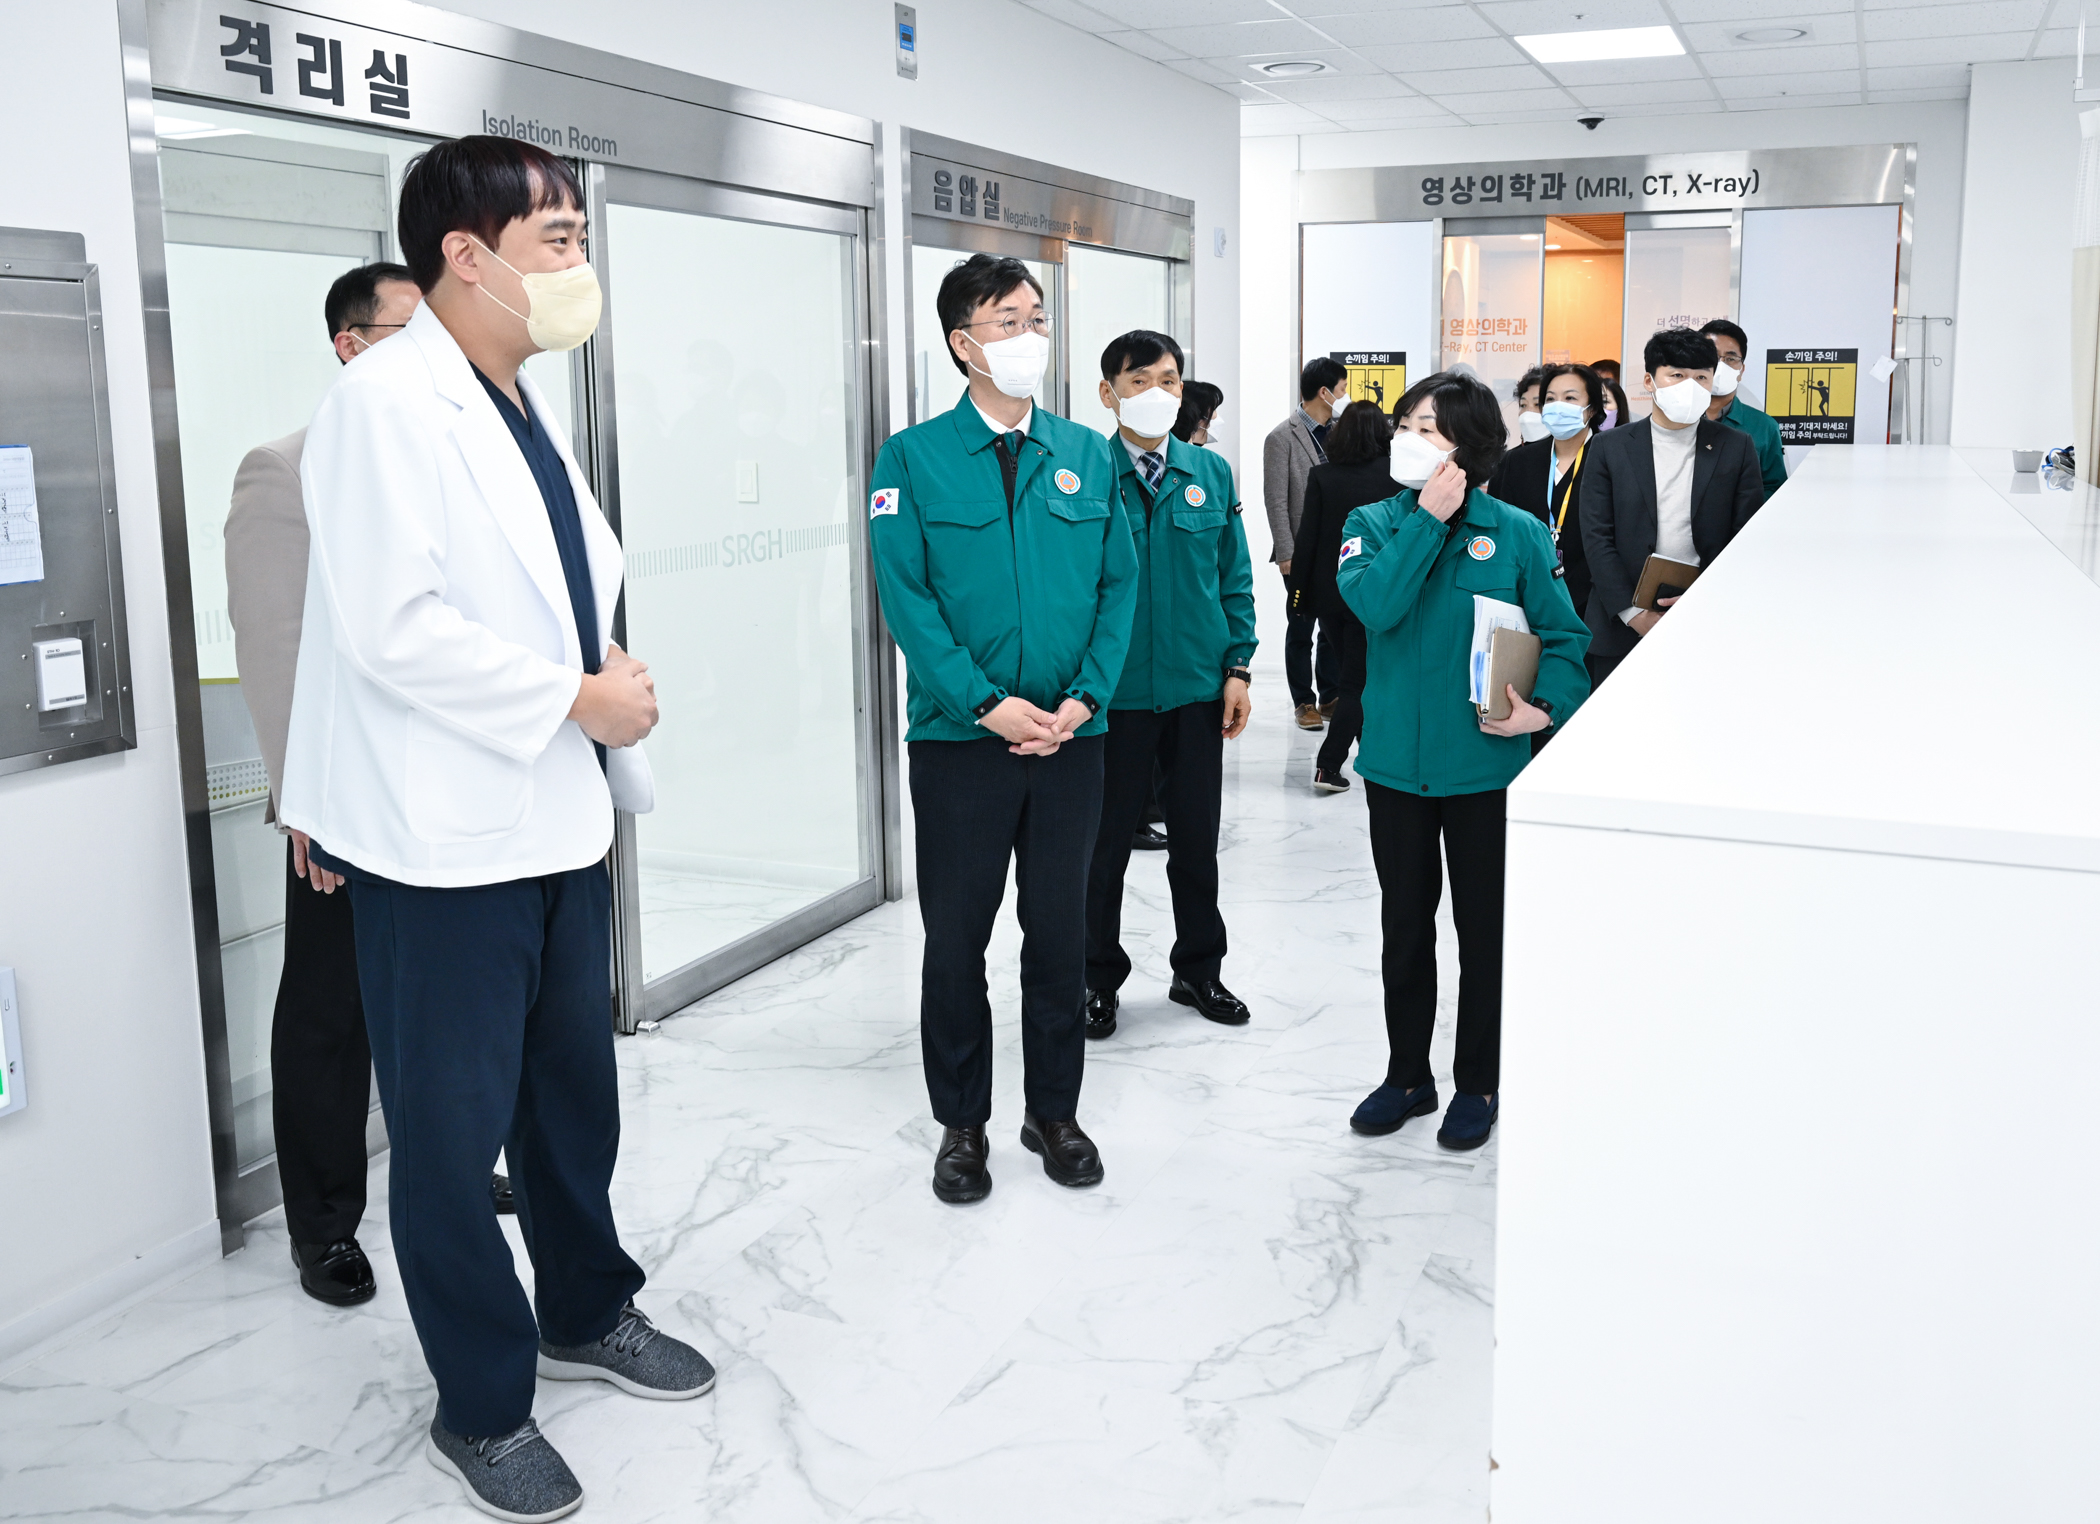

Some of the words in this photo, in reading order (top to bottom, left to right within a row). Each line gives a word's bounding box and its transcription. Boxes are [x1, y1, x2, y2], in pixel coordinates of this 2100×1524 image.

[219, 14, 411, 120] 격리실
[482, 109, 563, 147] Isolation
[568, 126, 618, 157] Room
[933, 169, 1000, 221] 음압실
[1421, 172, 1567, 206] 영상의학과
[1576, 175, 1634, 200] (MRI,
[1642, 174, 1678, 198] CT,
[1686, 169, 1760, 197] X-ray)
[1003, 207, 1038, 230] Negative
[1040, 213, 1072, 234] Pressure
[1073, 220, 1093, 238] Room
[1450, 318, 1528, 336] 영상의학과
[1345, 354, 1369, 363] 손끼임
[1370, 354, 1390, 363] 주의!
[1442, 341, 1472, 354] -Ray,
[1475, 341, 1489, 352] CT
[1492, 341, 1528, 352] Center
[1784, 351, 1813, 361] 손끼임
[1815, 351, 1838, 361] 주의!
[1780, 431, 1796, 439] 끼임
[1797, 431, 1812, 439] 주의
[1798, 422, 1820, 430] 기대지
[1822, 422, 1848, 430] 마세요!
[721, 528, 783, 568] SRGH
